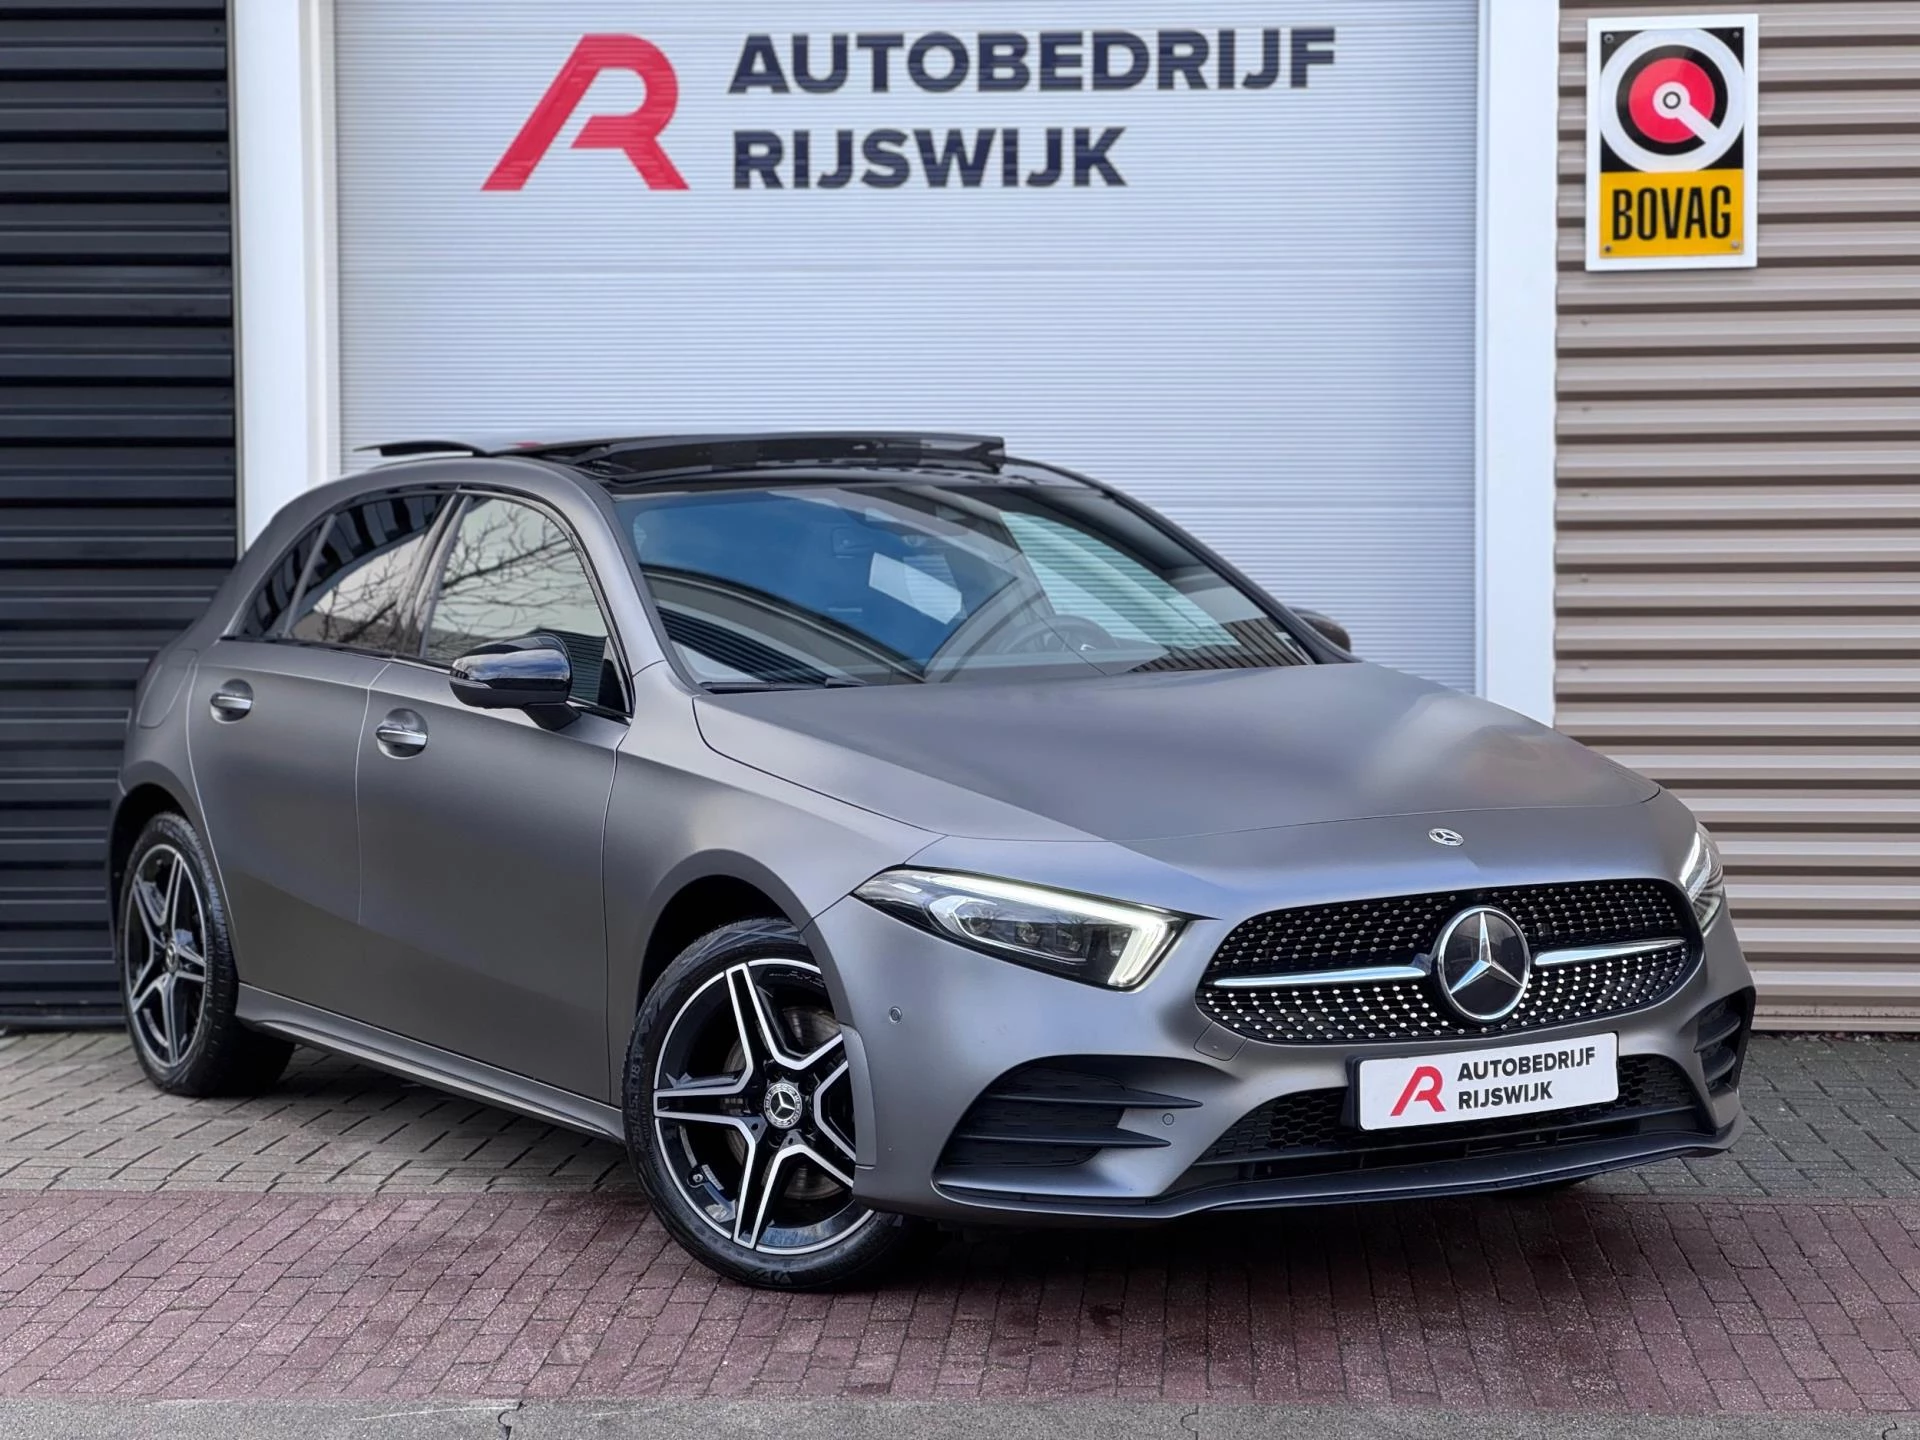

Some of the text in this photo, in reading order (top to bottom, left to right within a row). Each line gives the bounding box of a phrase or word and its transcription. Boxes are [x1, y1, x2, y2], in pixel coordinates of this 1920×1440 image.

[726, 27, 1337, 95] AUTOBEDRIJF
[732, 126, 1128, 190] RIJSWIJK
[1612, 185, 1731, 241] BOVAG
[1457, 1046, 1596, 1082] AUTOBEDRIJF
[1458, 1081, 1554, 1110] RIJSWIJK
